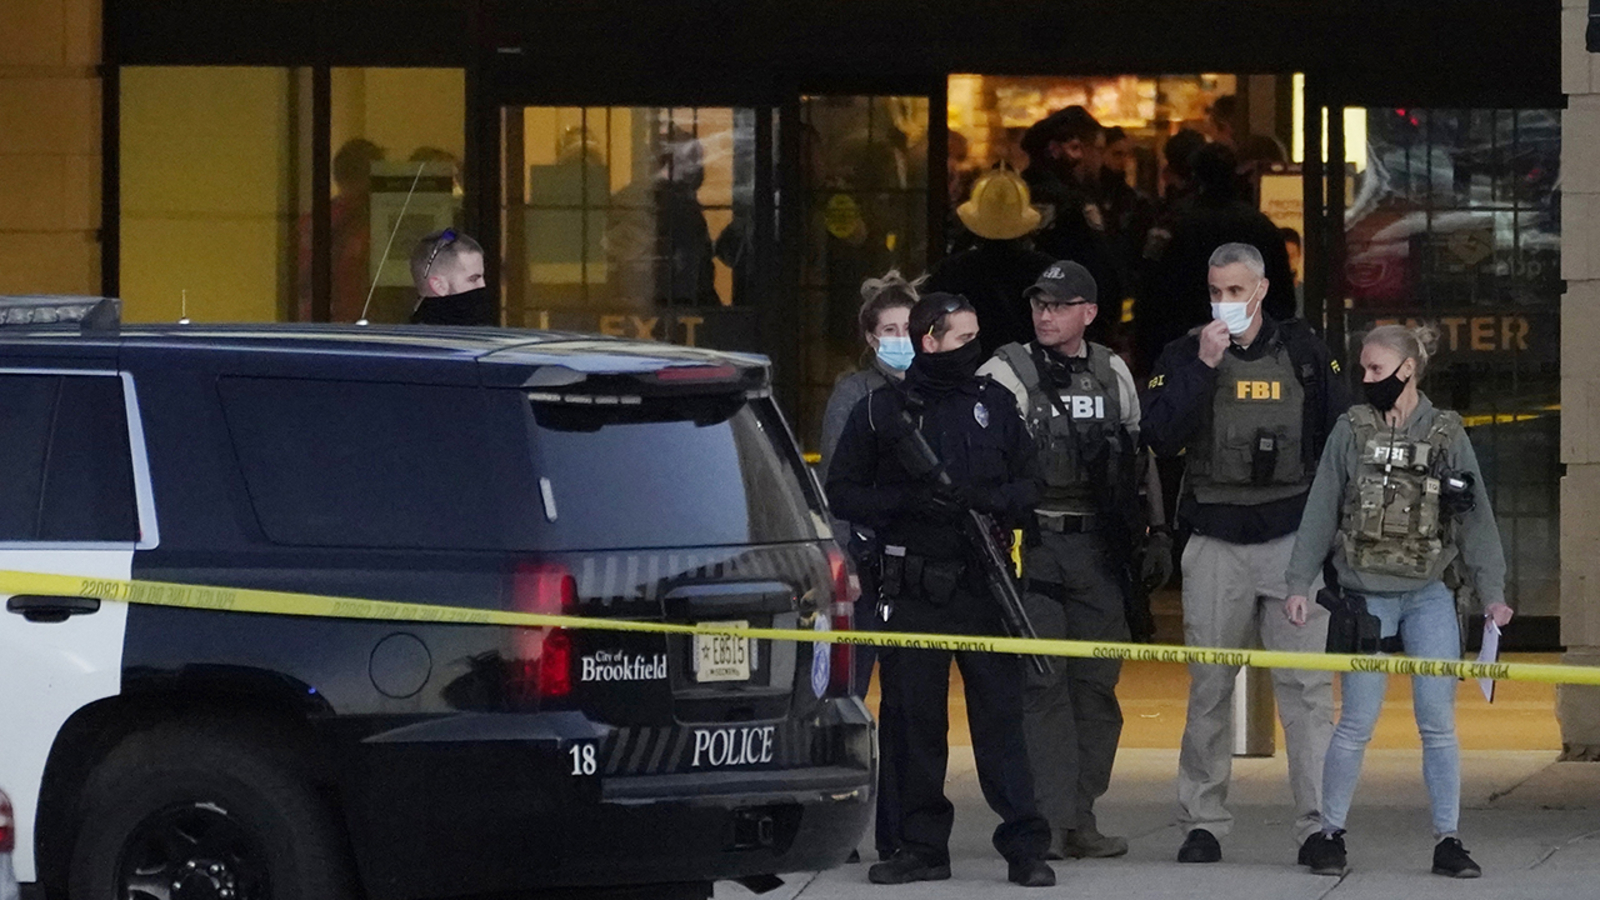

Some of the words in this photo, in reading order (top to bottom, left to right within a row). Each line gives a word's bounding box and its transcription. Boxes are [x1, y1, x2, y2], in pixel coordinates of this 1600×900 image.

[601, 315, 704, 347] EXT
[1237, 380, 1281, 400] FBI
[1374, 446, 1404, 461] FBI
[581, 653, 667, 681] Brookfield
[596, 650, 612, 663] City
[613, 649, 623, 662] of
[569, 744, 596, 775] 18
[692, 726, 774, 766] POLICE
